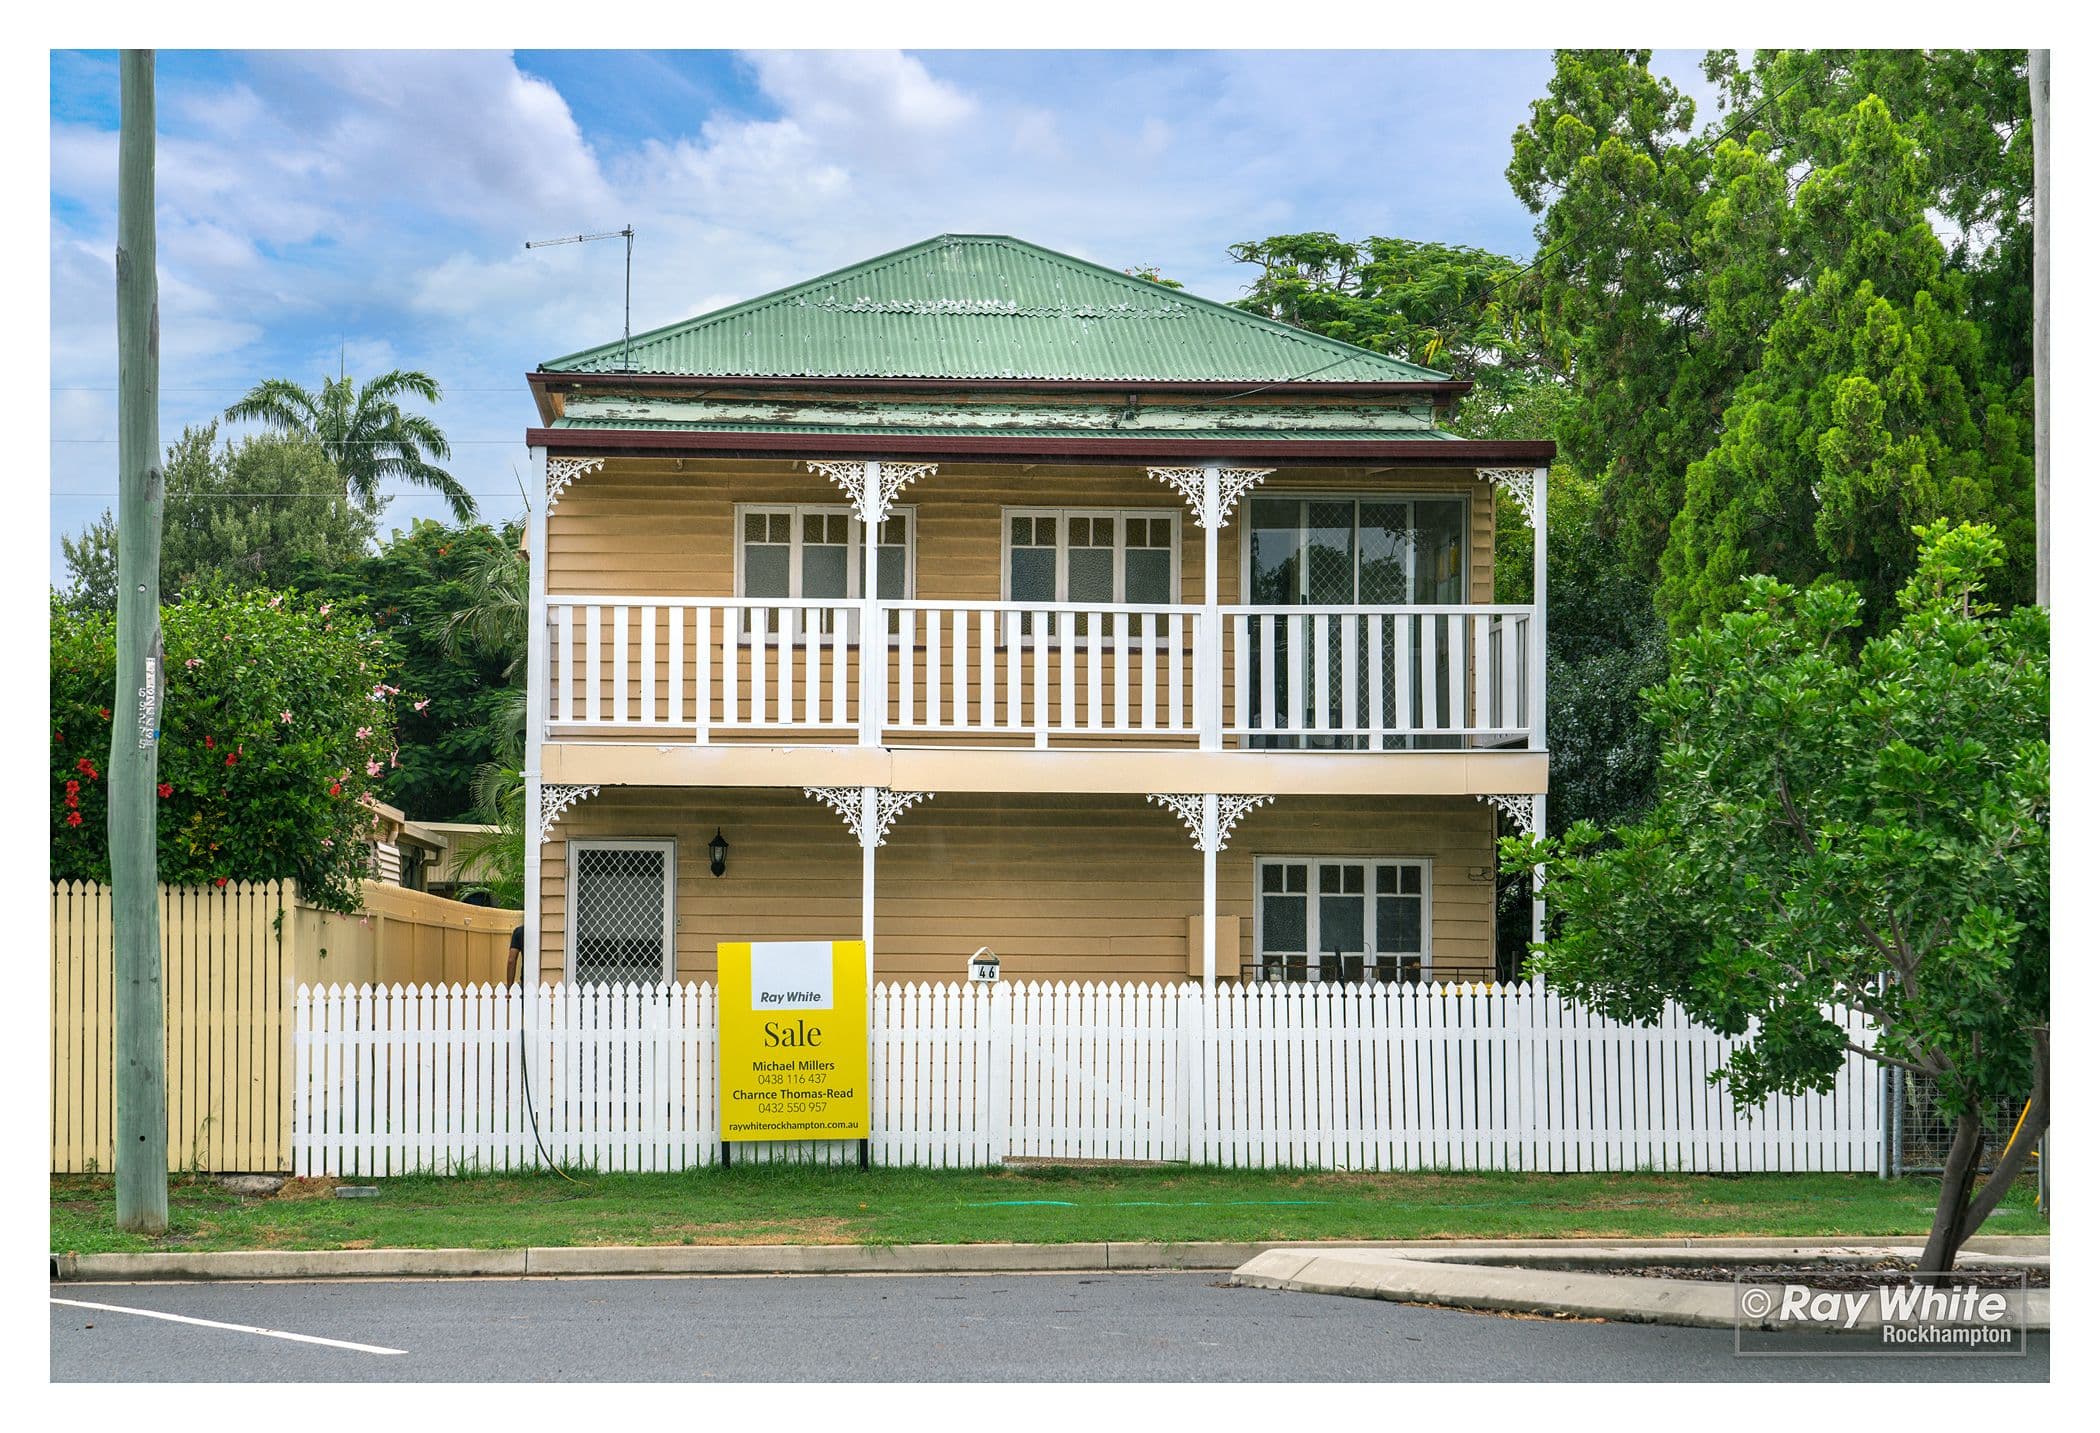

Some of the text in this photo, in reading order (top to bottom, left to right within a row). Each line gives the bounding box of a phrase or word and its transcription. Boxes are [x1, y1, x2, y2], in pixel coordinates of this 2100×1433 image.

[979, 966, 995, 978] 46
[761, 991, 822, 1004] Ray White
[764, 1019, 822, 1048] Sale
[752, 1061, 835, 1071] Michael Millers
[758, 1073, 827, 1085] 0438 116 437
[733, 1089, 854, 1100] Charnce Thomas-Read
[758, 1102, 828, 1114] 0432 550 957
[729, 1121, 859, 1132] raywhiterockhampton.com.au
